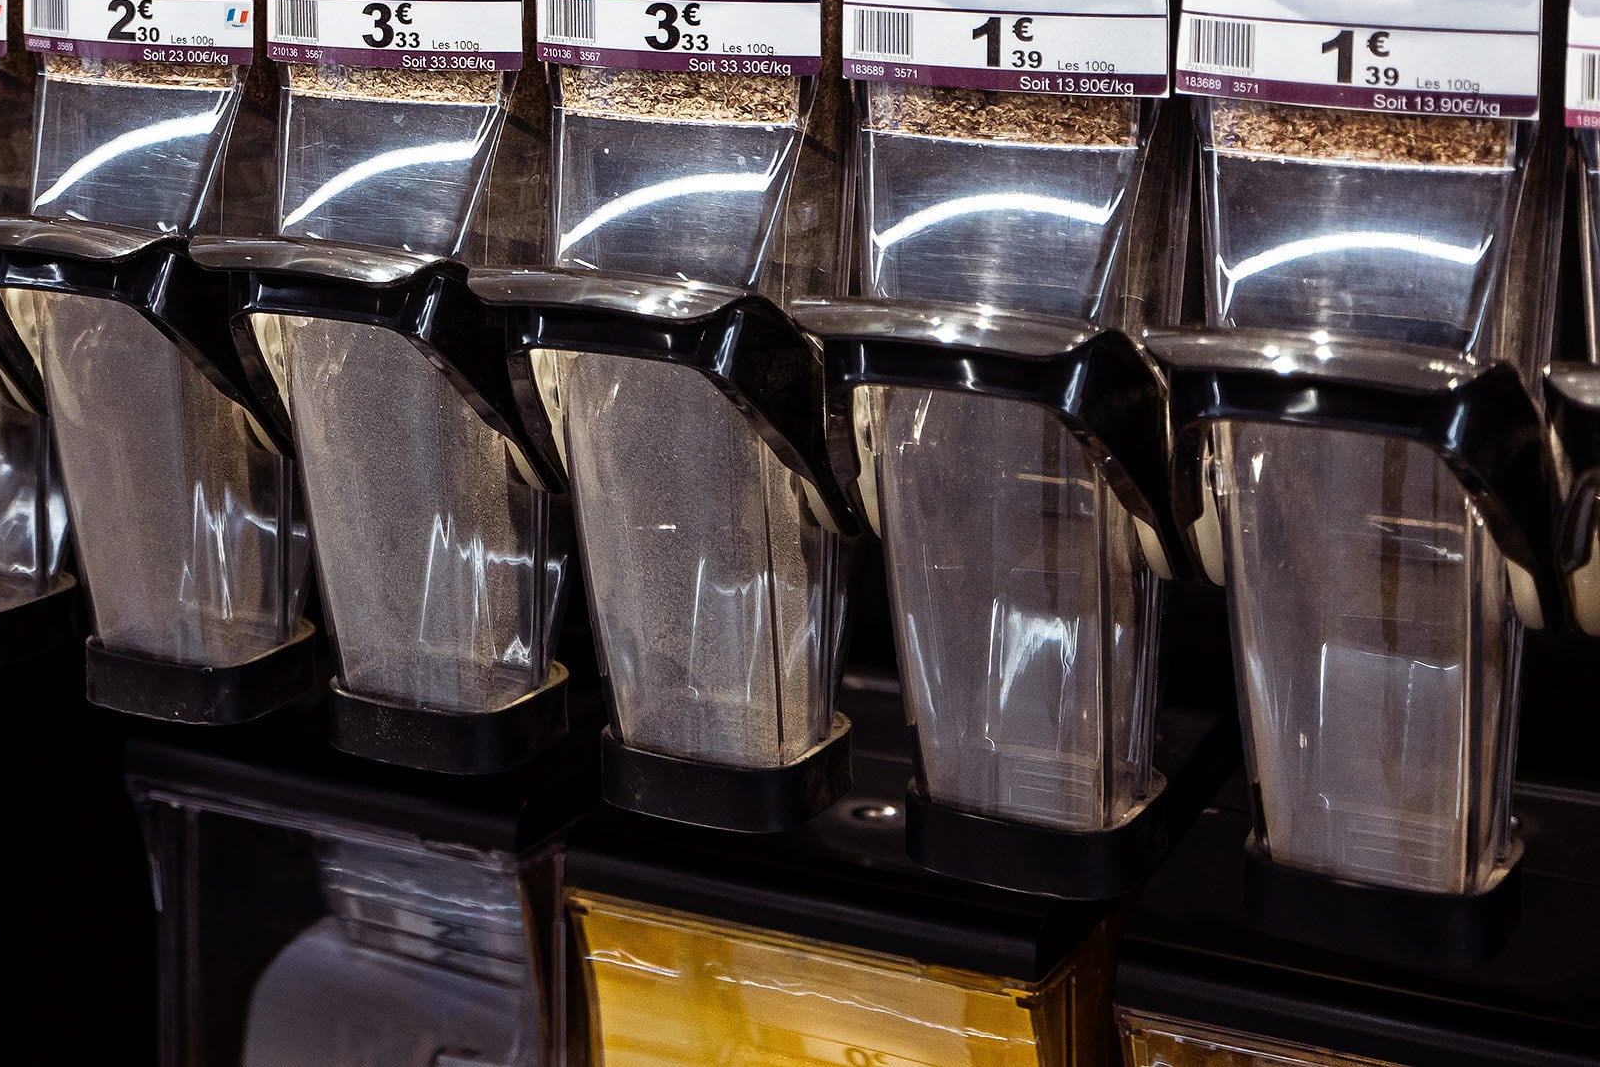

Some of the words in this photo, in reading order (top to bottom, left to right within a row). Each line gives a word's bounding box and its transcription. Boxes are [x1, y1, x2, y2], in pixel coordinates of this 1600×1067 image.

[171, 35, 187, 45] Les
[432, 40, 450, 50] Les
[305, 50, 323, 59] 3567
[543, 48, 571, 59] 210136
[580, 51, 600, 61] 3567
[722, 43, 742, 53] Les
[144, 49, 165, 61] Soit
[169, 51, 228, 65] 23.00€/kg
[402, 55, 426, 68] Soit
[430, 56, 496, 71] 33.30€/kg
[689, 59, 716, 72] Soit
[720, 60, 791, 75] 33.30€/kg
[851, 64, 884, 76] 183689
[894, 68, 918, 78] 3571
[1058, 60, 1079, 71] Les
[1020, 77, 1050, 90] Soit
[1056, 79, 1134, 94] 13.90€/kg
[1185, 76, 1221, 90] 183689
[1233, 82, 1258, 93] 3571
[1417, 78, 1441, 89] Les
[1374, 95, 1407, 109] Soit
[1414, 97, 1500, 116] 13.90€/kg
